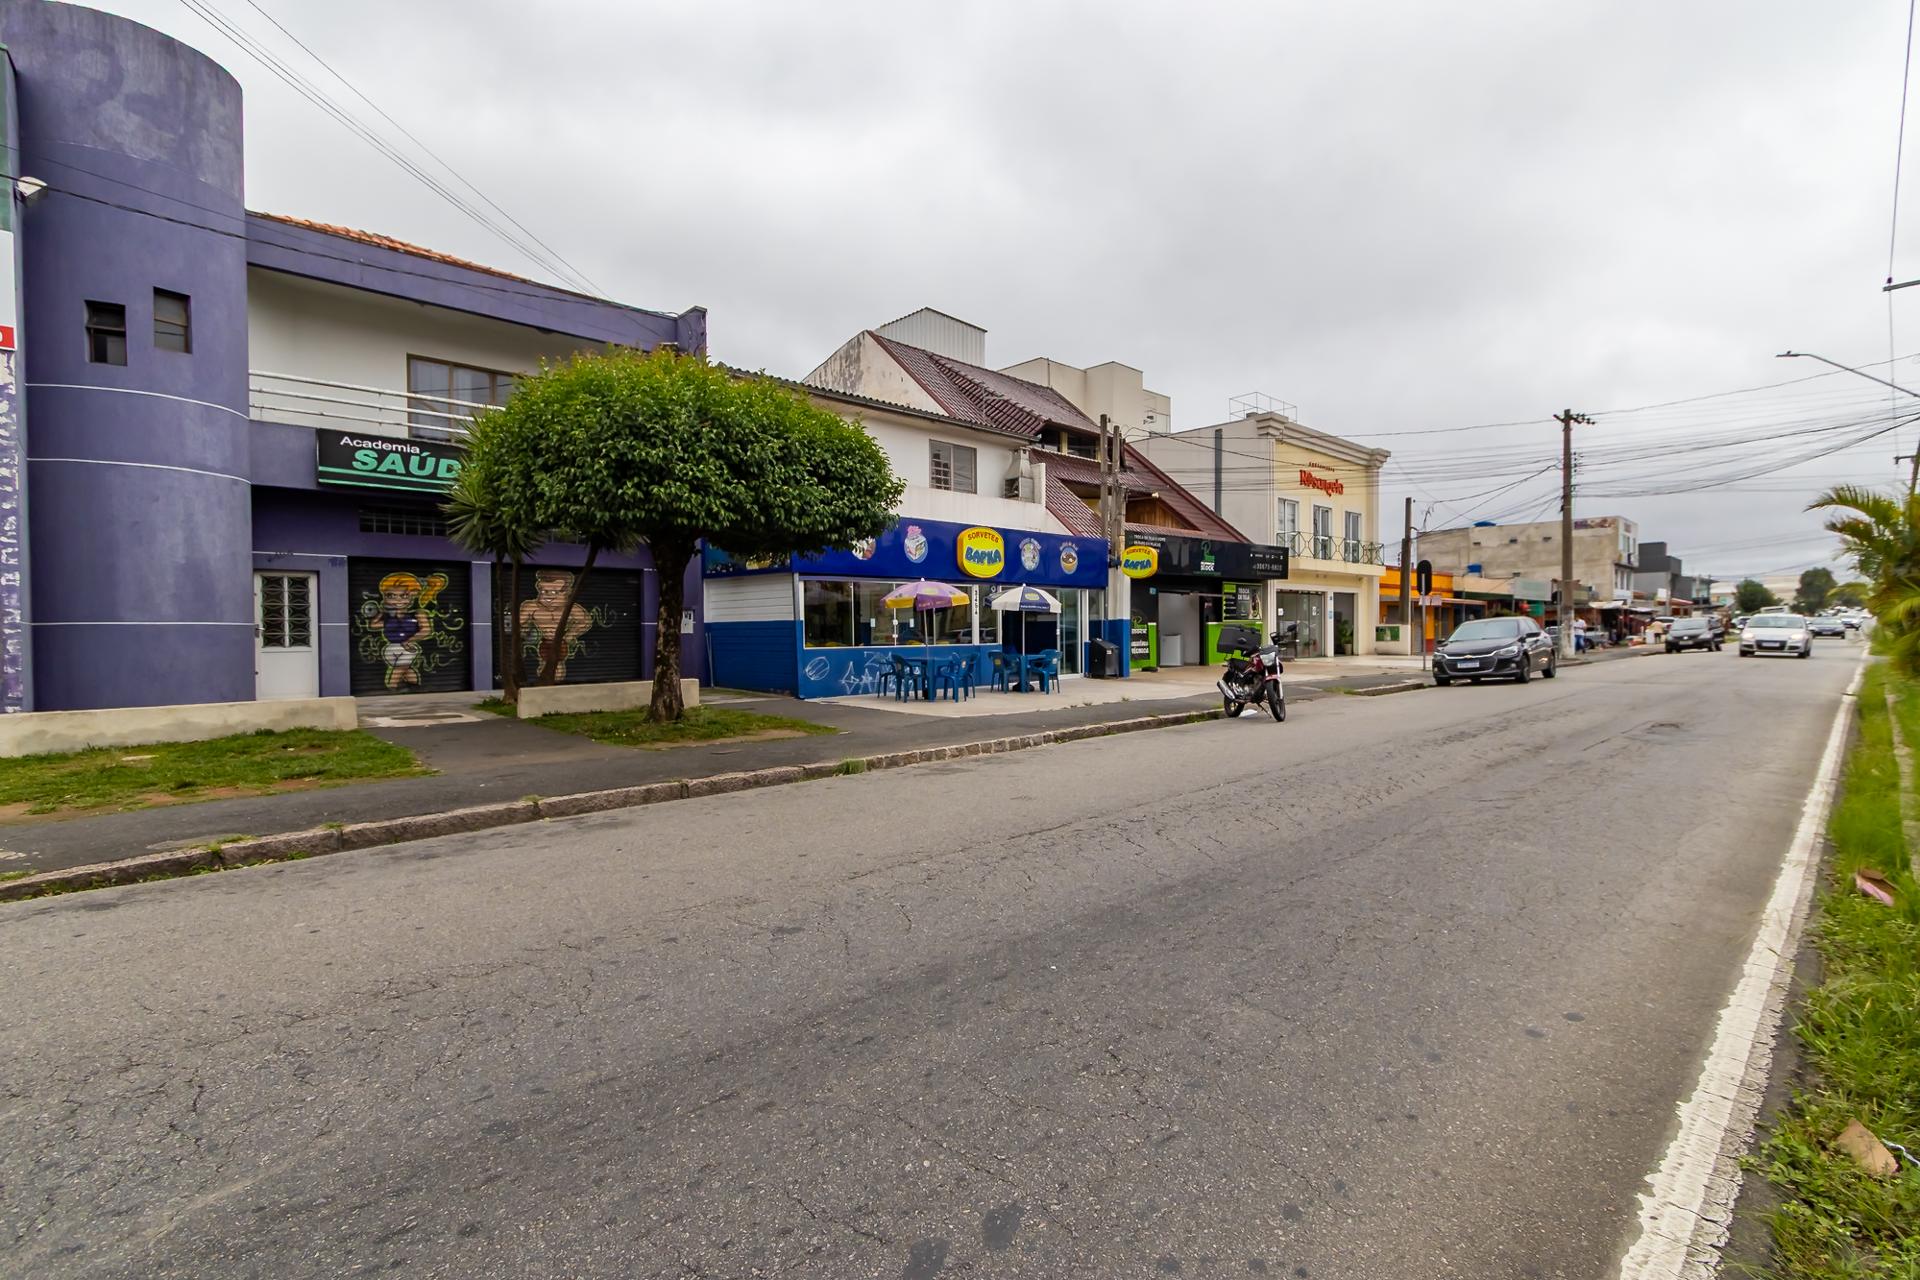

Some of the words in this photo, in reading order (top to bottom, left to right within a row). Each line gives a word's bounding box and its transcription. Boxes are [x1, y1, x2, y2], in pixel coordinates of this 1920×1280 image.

[340, 436, 420, 454] Academia
[352, 449, 468, 478] SAÚD
[967, 531, 999, 543] SORVETES
[965, 546, 1002, 565] BAPKA
